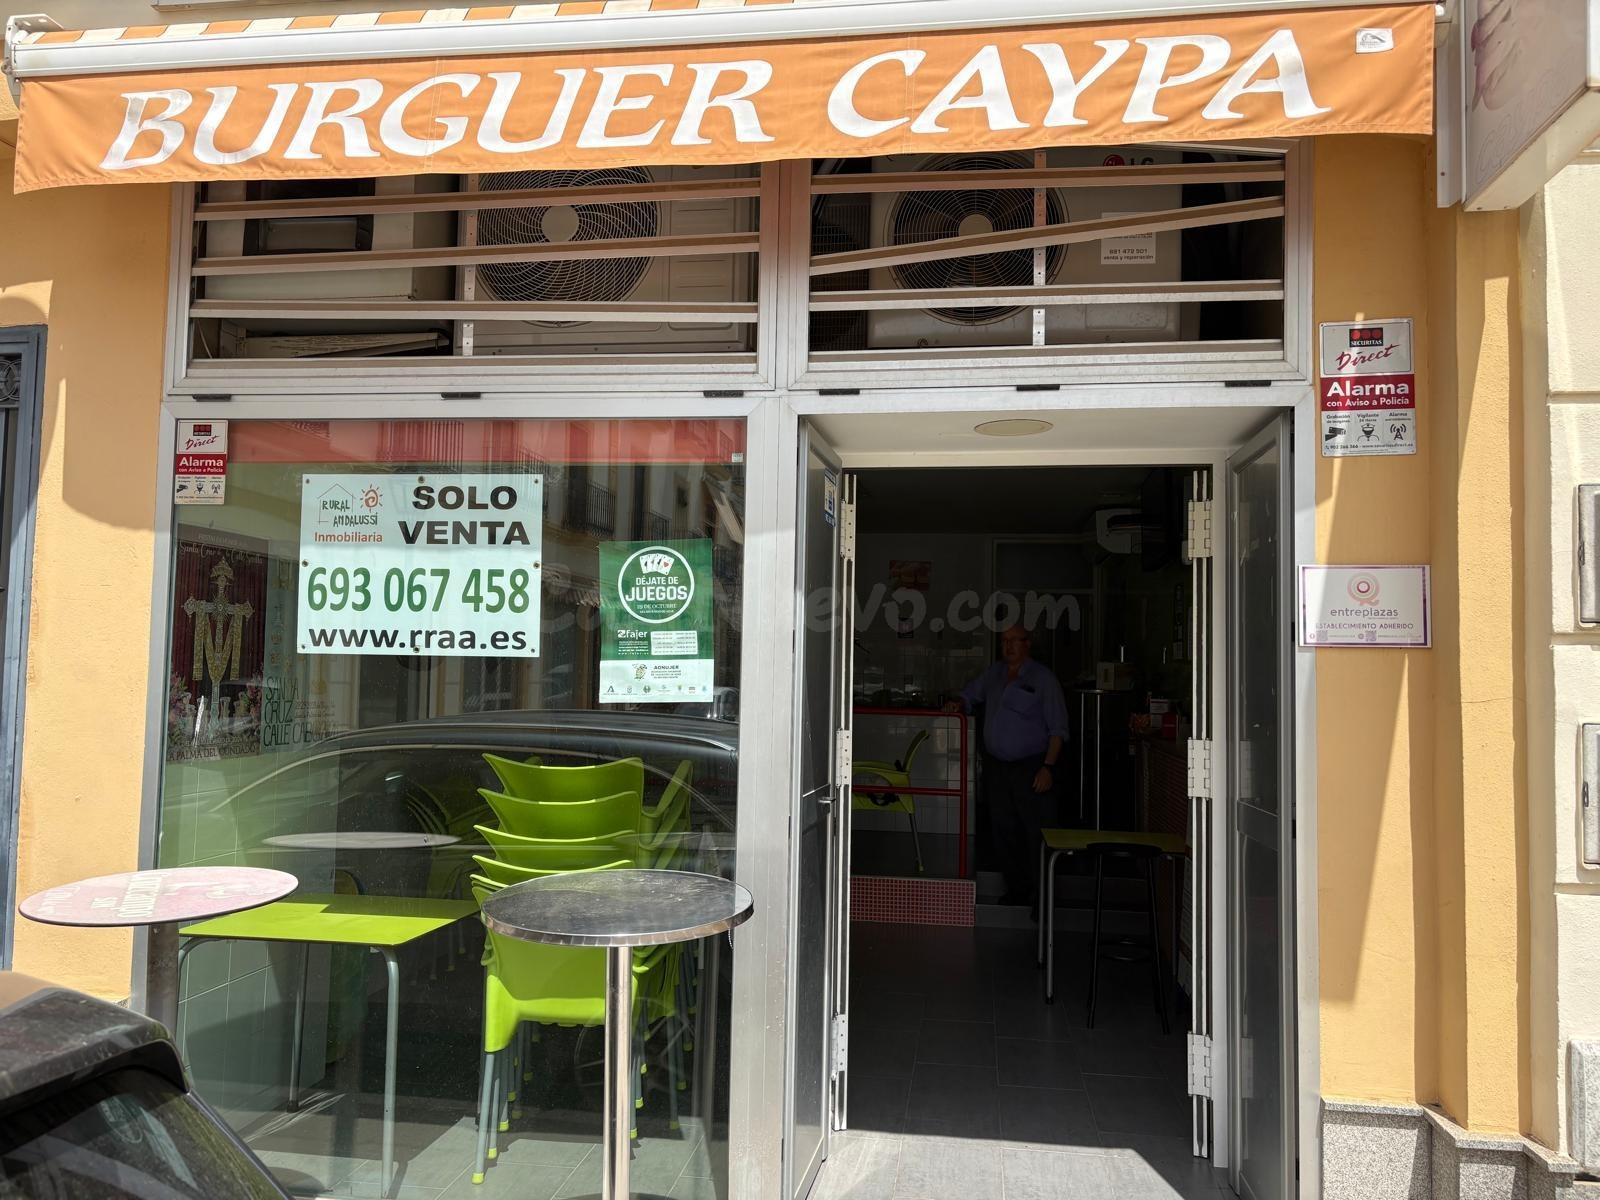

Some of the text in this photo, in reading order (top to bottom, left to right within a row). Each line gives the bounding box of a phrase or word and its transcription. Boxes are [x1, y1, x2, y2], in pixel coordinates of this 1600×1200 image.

[100, 29, 1332, 170] BURGUER CAYPA
[1336, 344, 1400, 370] Direct
[1327, 380, 1409, 397] Alarma
[1345, 399, 1369, 407] Aviso
[185, 435, 220, 450] Direct
[179, 456, 223, 467] Alarma
[322, 499, 350, 511] RURAL
[412, 485, 518, 510] SOLO
[314, 532, 383, 542] Inmobiliaria
[398, 521, 531, 545] VENTA
[635, 575, 679, 586] DÉJATE DE
[307, 567, 530, 614] 693 067 458
[625, 585, 688, 601] JUEGOS
[1330, 607, 1399, 619] entreplazas
[308, 628, 527, 651] www.rraa.es
[264, 700, 294, 724] CRUZ
